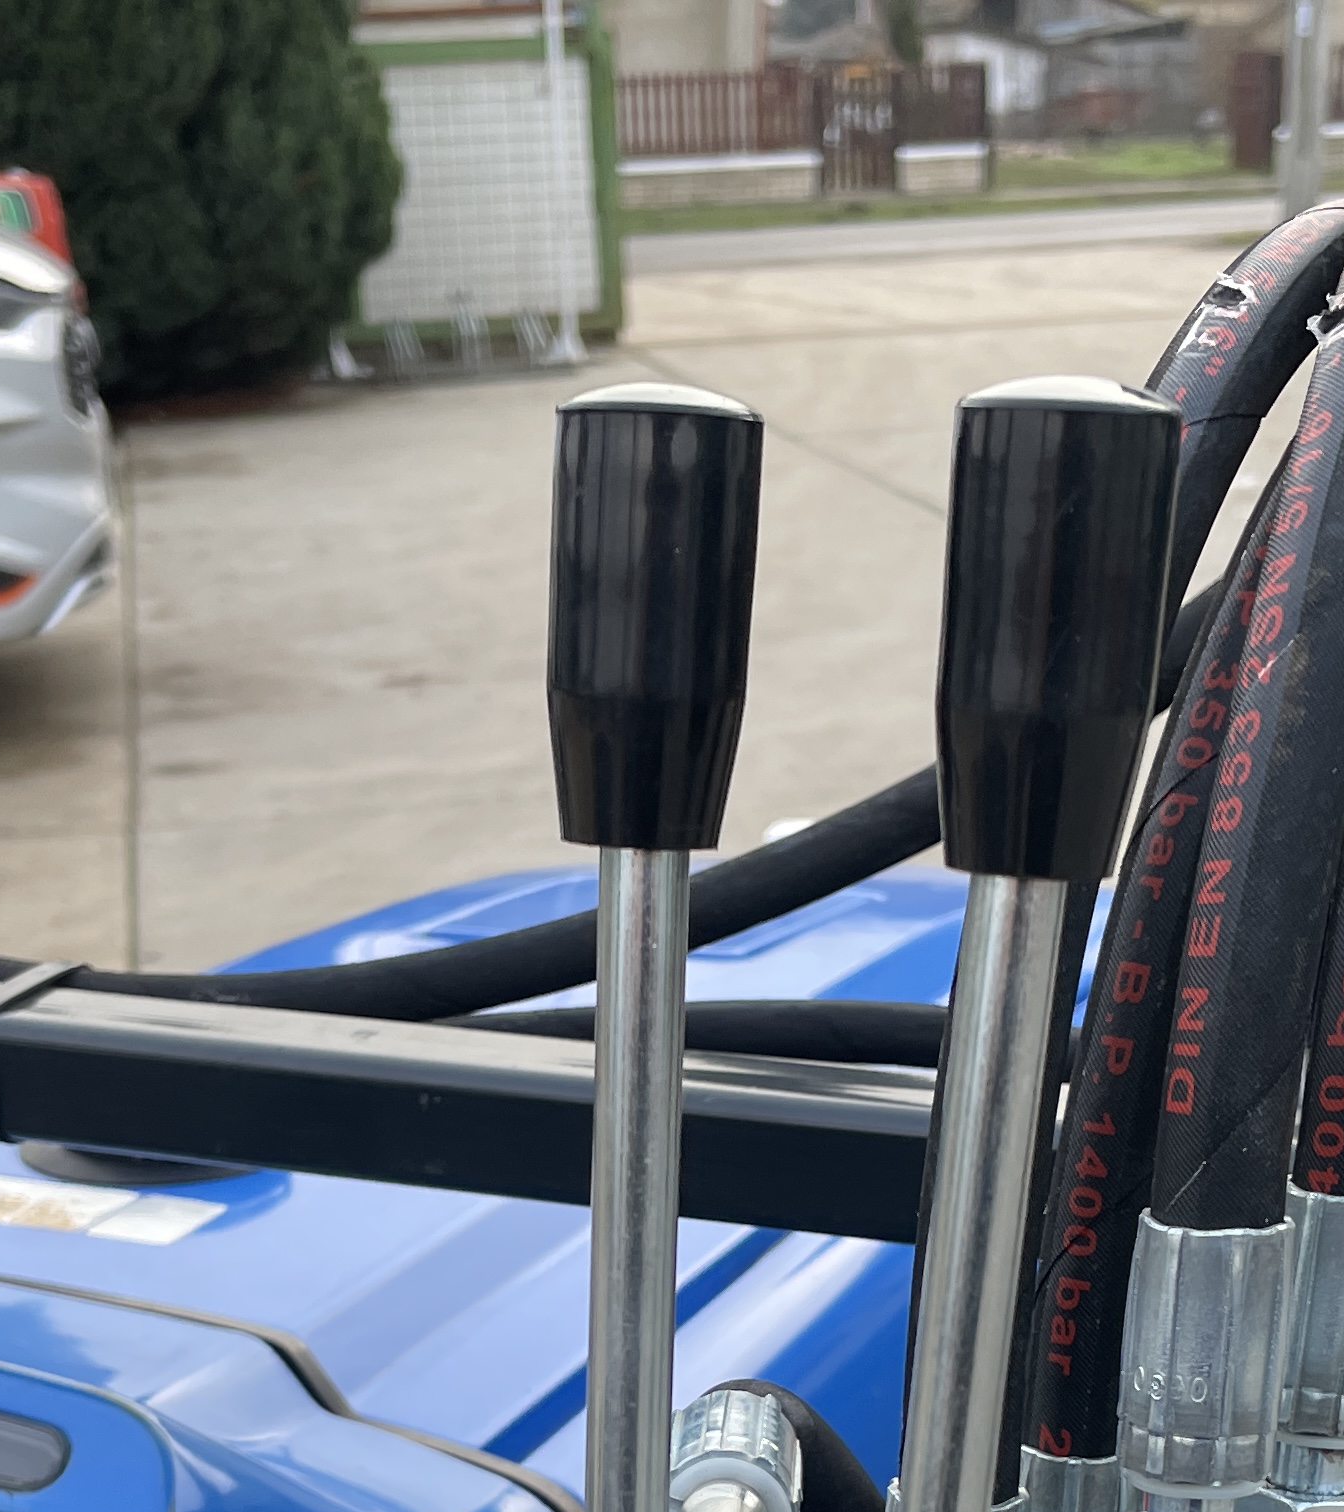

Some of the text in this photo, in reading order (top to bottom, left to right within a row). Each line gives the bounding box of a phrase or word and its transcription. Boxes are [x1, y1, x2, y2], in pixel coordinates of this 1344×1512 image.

[1240, 552, 1296, 689] 2SN
[1176, 658, 1239, 771] 350
[1210, 707, 1262, 834] 853
[1138, 791, 1199, 902] bar
[1187, 857, 1233, 958] EN
[1092, 960, 1152, 1084] B.P.
[1165, 986, 1210, 1117] DIN
[1062, 1110, 1117, 1258] 1400
[1046, 1279, 1093, 1377] bar
